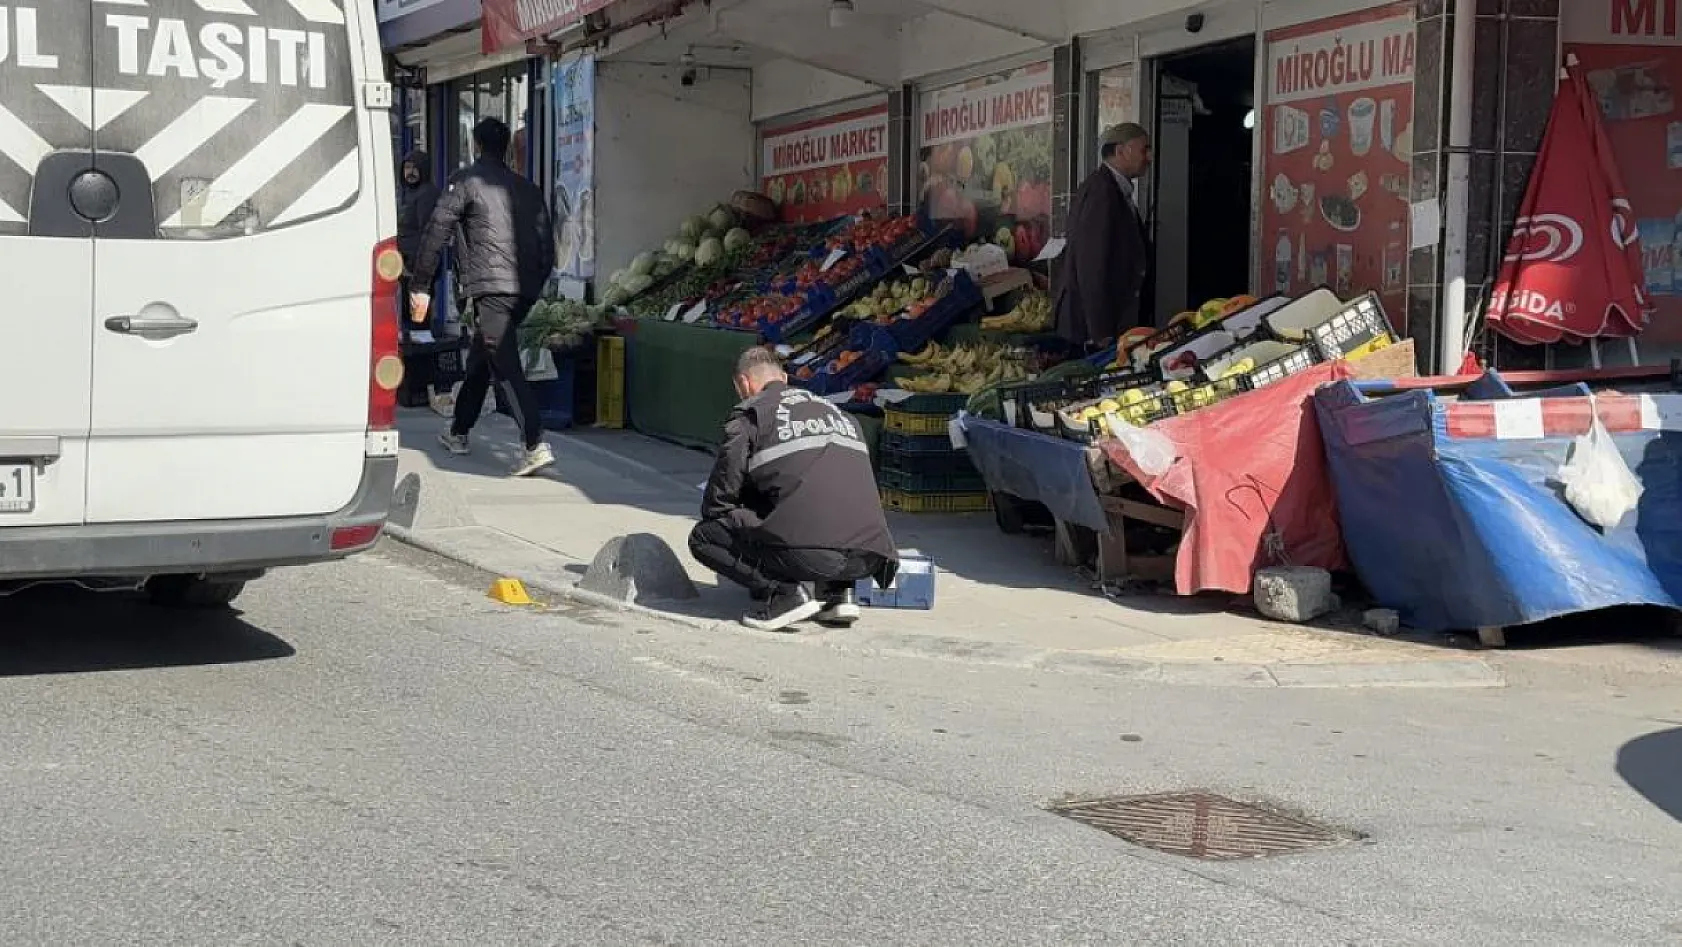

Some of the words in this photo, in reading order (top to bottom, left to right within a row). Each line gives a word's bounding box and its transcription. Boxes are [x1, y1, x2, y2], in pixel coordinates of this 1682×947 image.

[106, 14, 326, 88] TAŞITI
[1276, 34, 1375, 95] MİROĞLU
[925, 97, 987, 141] MİROĞLU
[773, 135, 827, 170] MİROĞLU
[830, 125, 886, 160] MARKET
